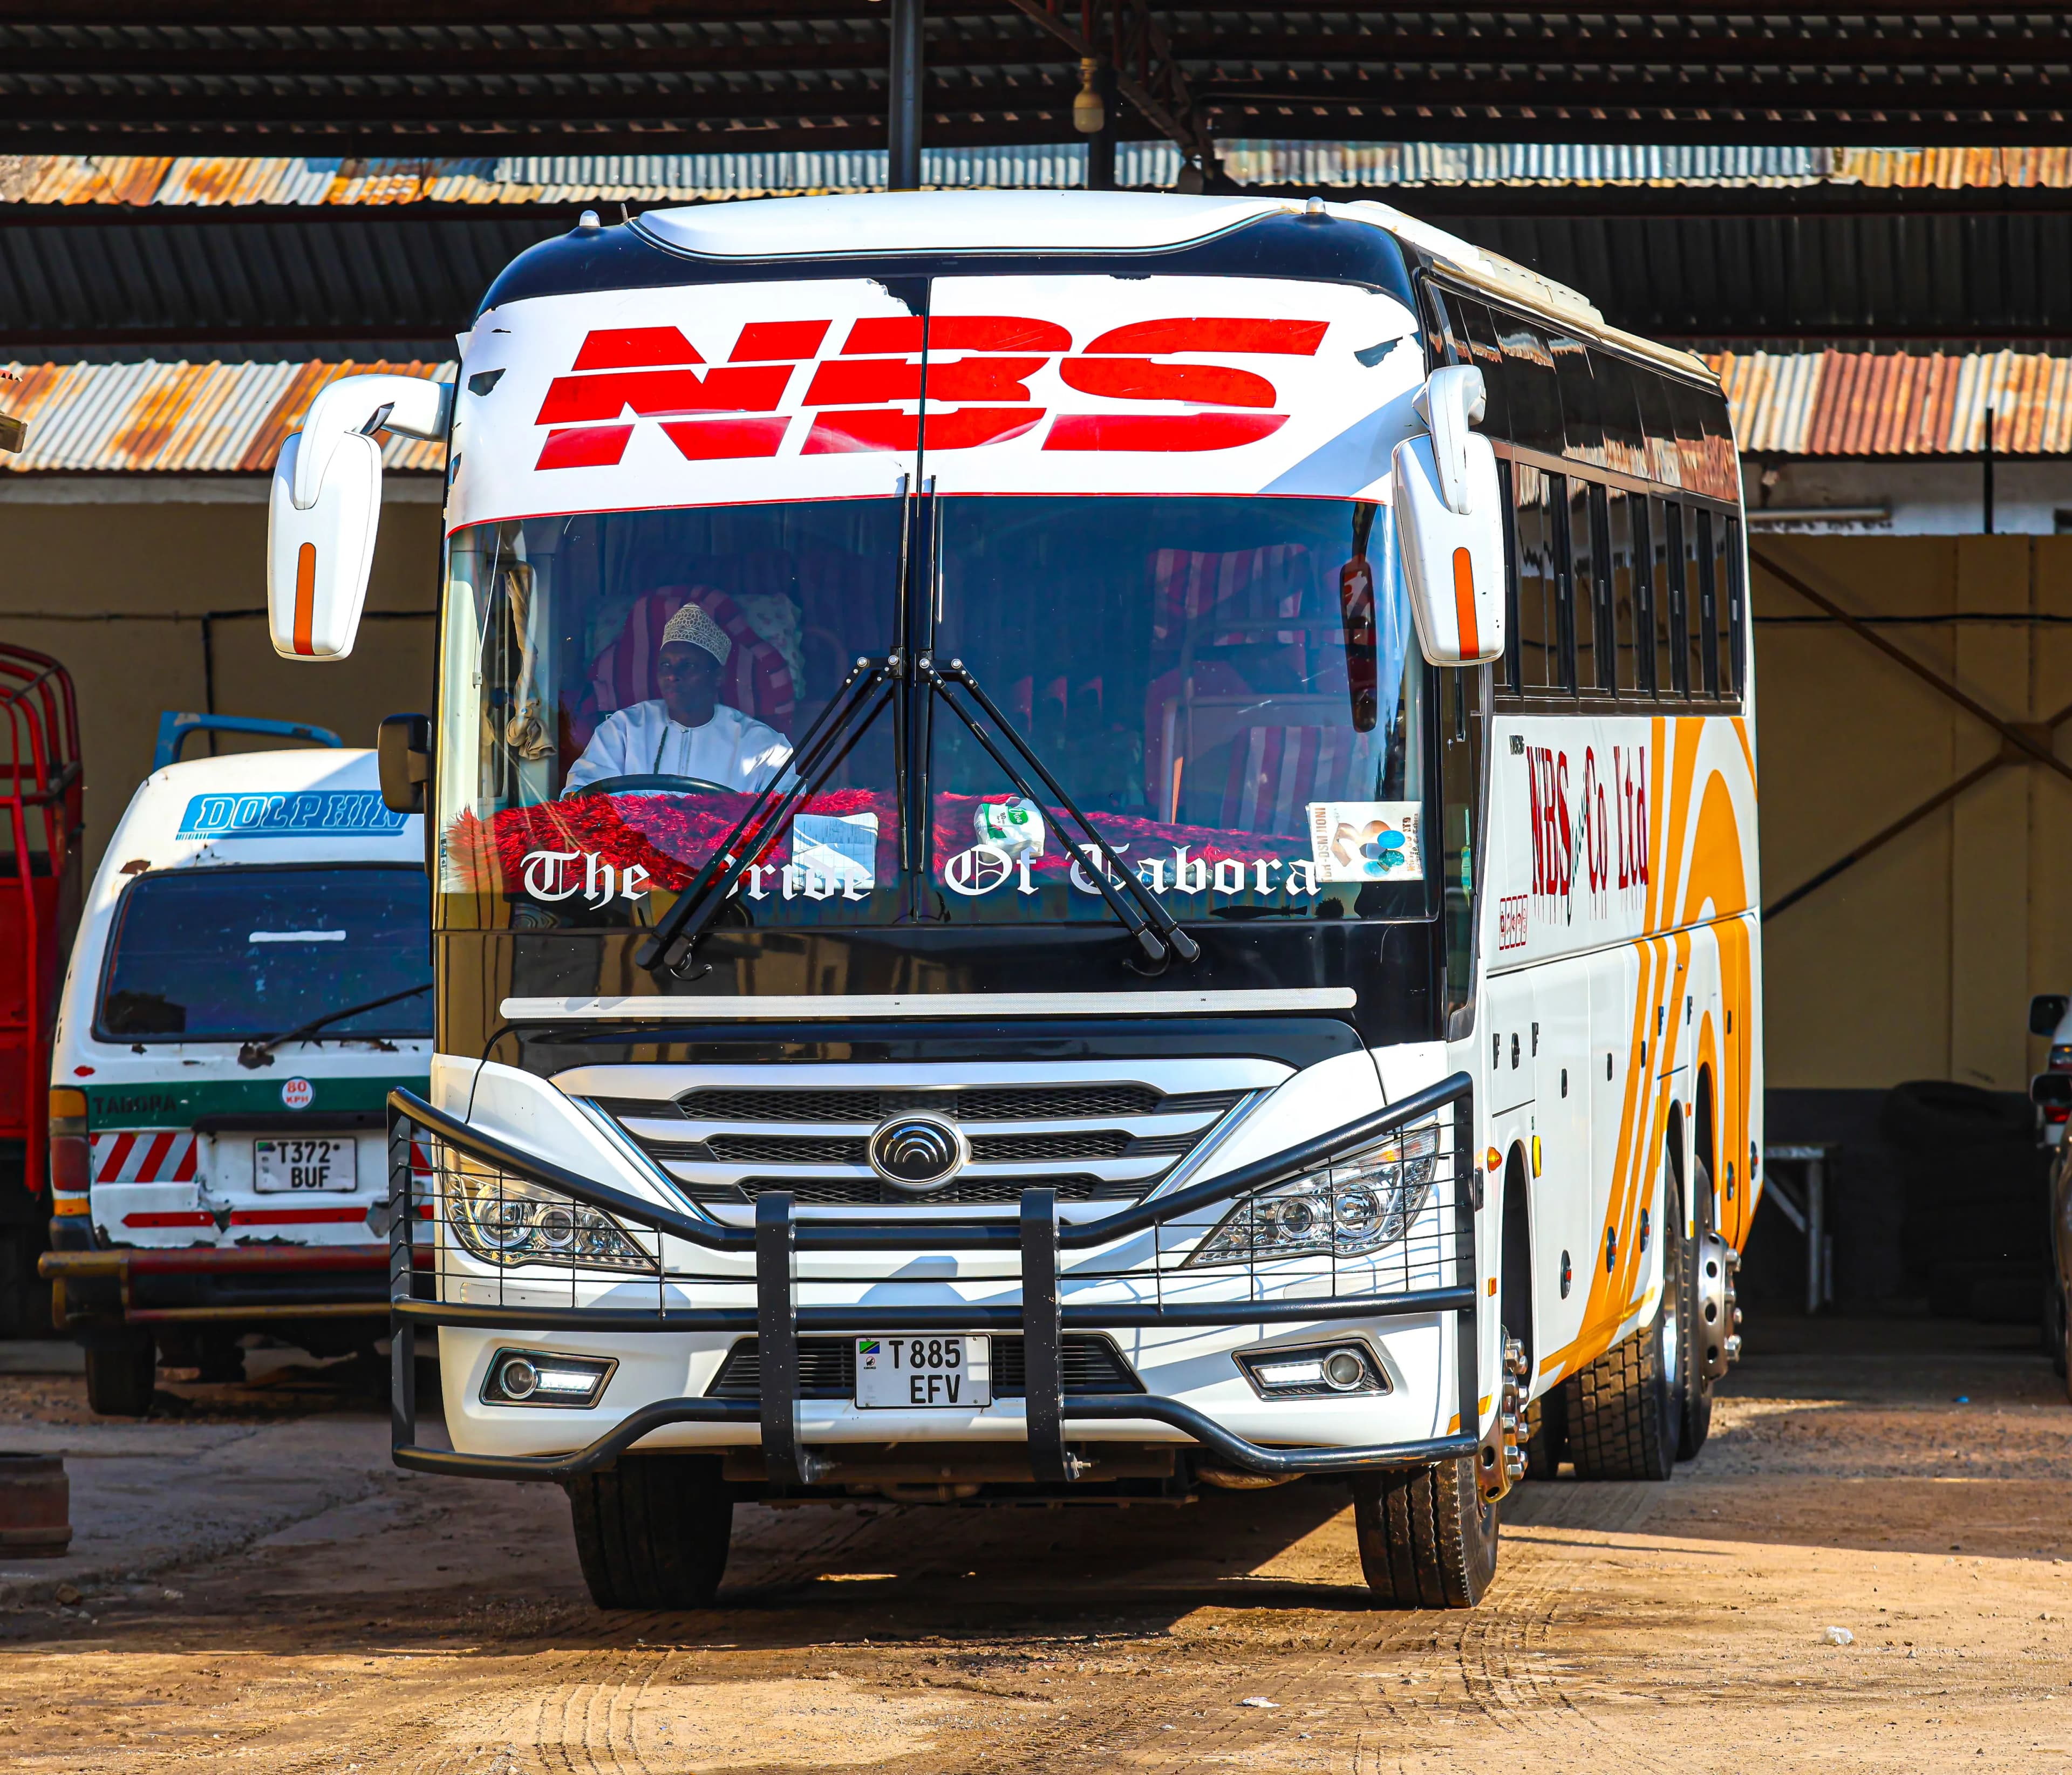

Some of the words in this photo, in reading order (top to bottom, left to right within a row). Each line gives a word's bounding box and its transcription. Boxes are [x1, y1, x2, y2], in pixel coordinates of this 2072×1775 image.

[534, 316, 1331, 472] NBS
[193, 794, 405, 829] DOLPHIN
[1314, 807, 1327, 834] JIONI
[1526, 746, 1571, 896] NBS
[1585, 745, 1607, 894] Co
[1613, 746, 1648, 890] Ltd
[520, 850, 650, 911] The
[944, 843, 1039, 896] Of
[1065, 843, 1323, 896] Tabora
[285, 1095, 309, 1104] KPH
[287, 1081, 308, 1093] 80
[93, 1095, 176, 1115] TABORA
[276, 1141, 331, 1164] T372
[290, 1167, 330, 1189] BUF
[910, 1374, 960, 1404] EFV
